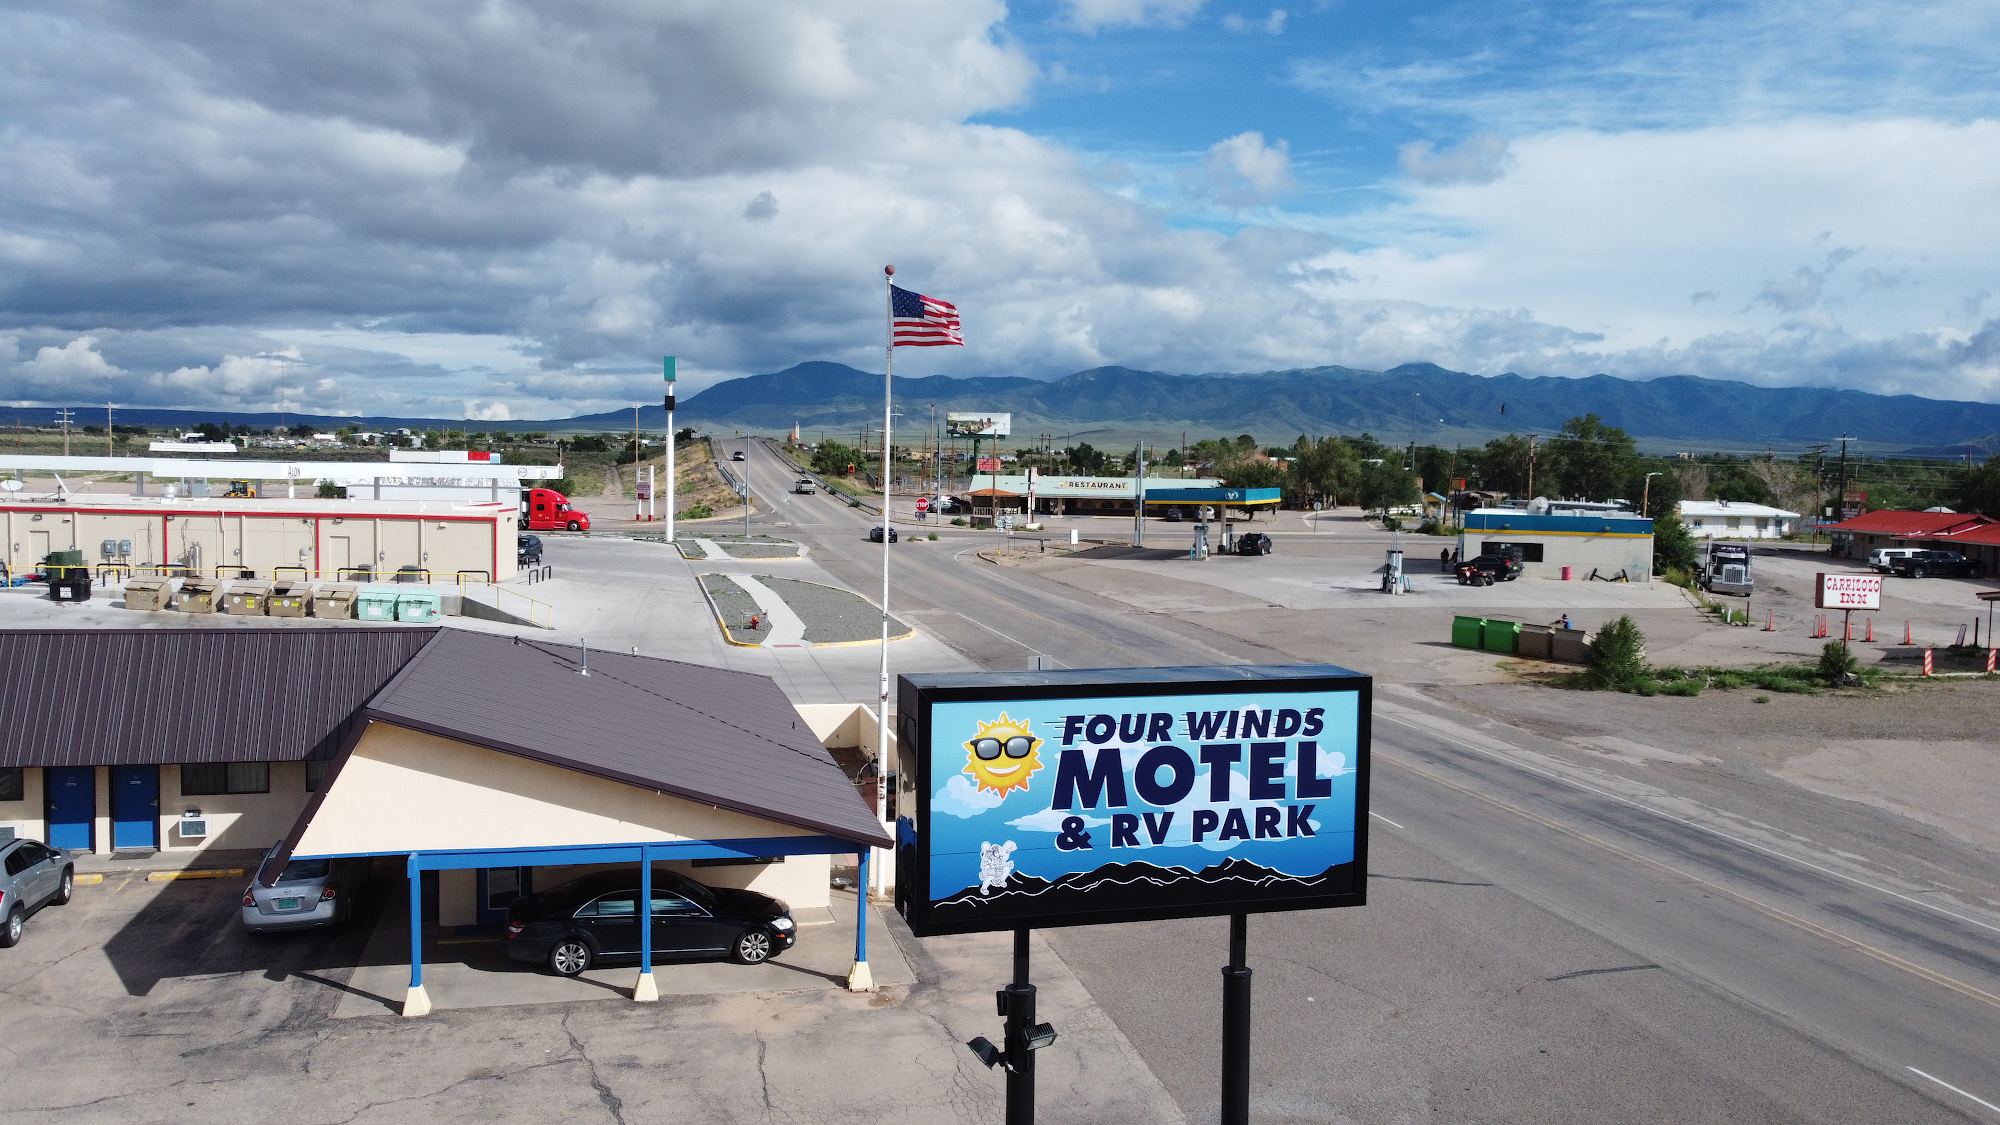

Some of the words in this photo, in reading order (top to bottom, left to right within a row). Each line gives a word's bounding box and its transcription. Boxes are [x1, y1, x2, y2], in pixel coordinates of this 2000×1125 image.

[1068, 481, 1127, 489] RESTAURANT
[1826, 577, 1880, 593] CARRIZOZO
[1839, 592, 1867, 604] INN
[1061, 712, 1174, 746] FOUR
[1186, 707, 1326, 741] WINDS
[1051, 740, 1332, 811] MOTEL
[1055, 815, 1093, 851] &
[1110, 811, 1175, 848] RV
[1192, 804, 1317, 845] PARK
